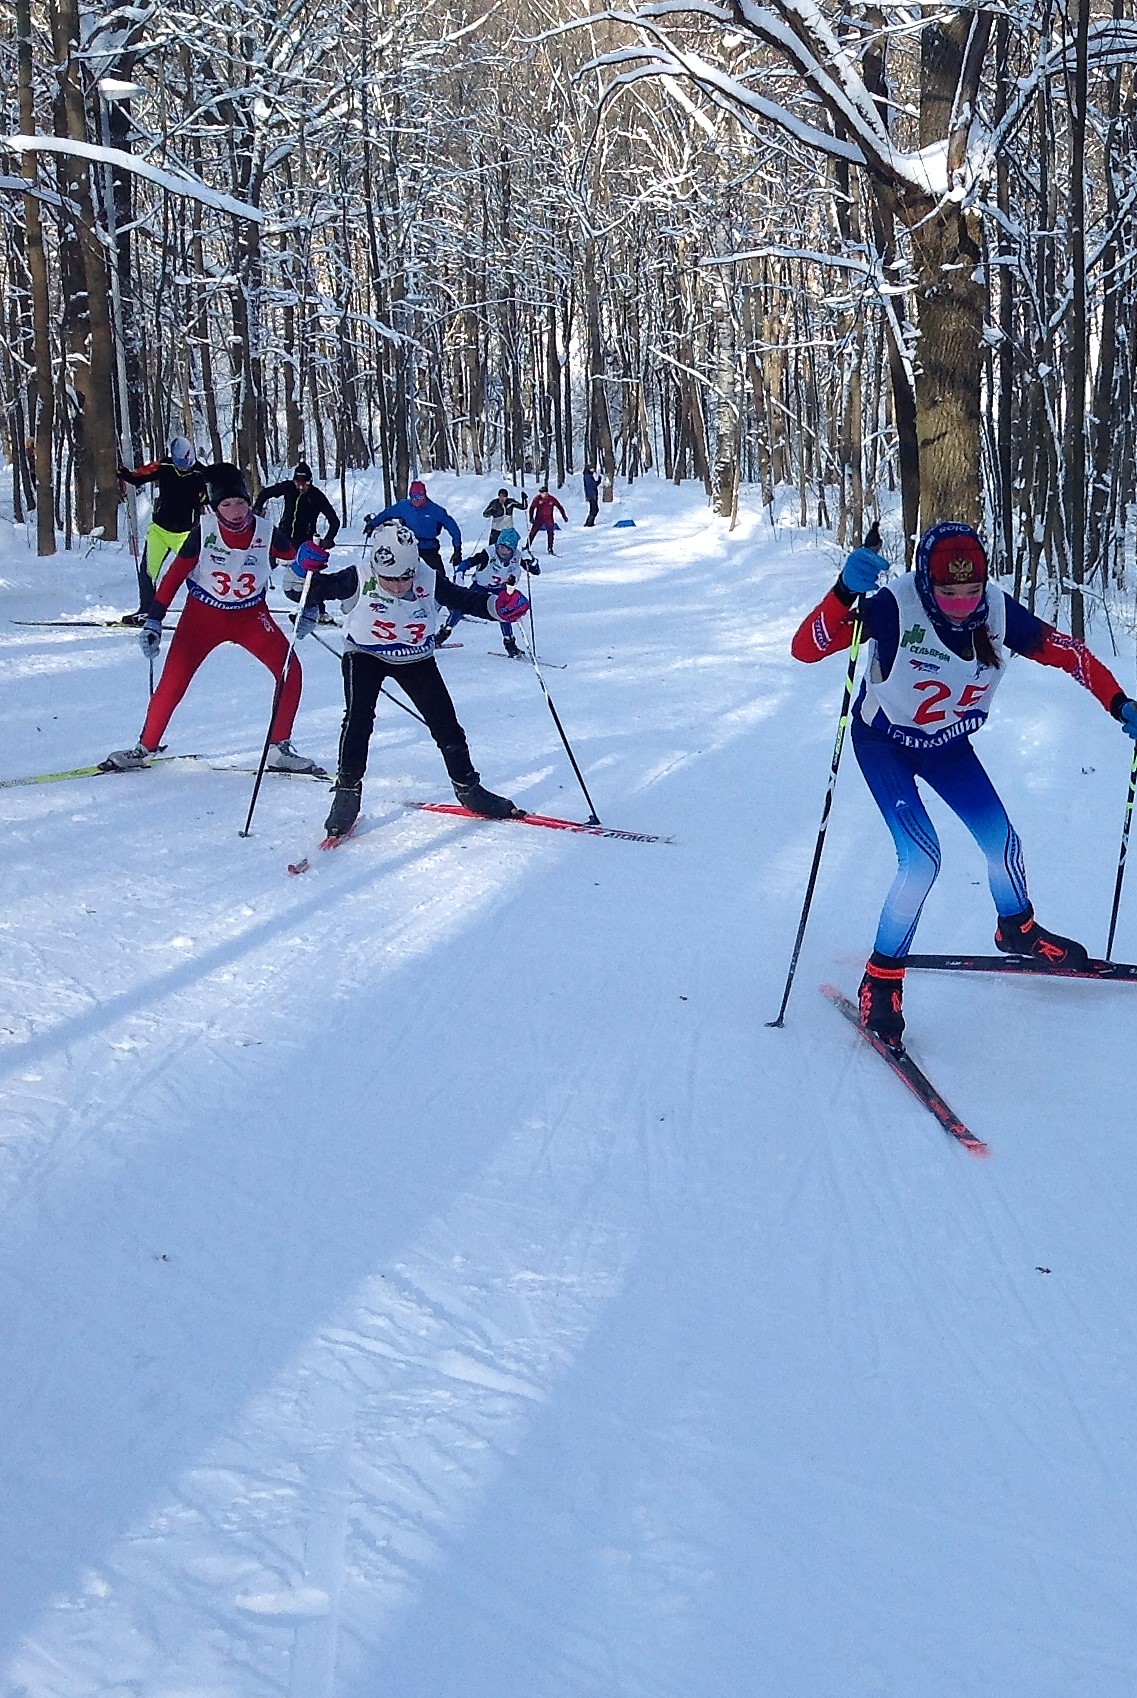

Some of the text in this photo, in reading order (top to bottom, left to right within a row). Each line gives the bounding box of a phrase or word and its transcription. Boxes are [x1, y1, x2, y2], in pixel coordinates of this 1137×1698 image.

[211, 571, 257, 599] 33
[371, 619, 427, 645] 53
[912, 680, 990, 726] 25
